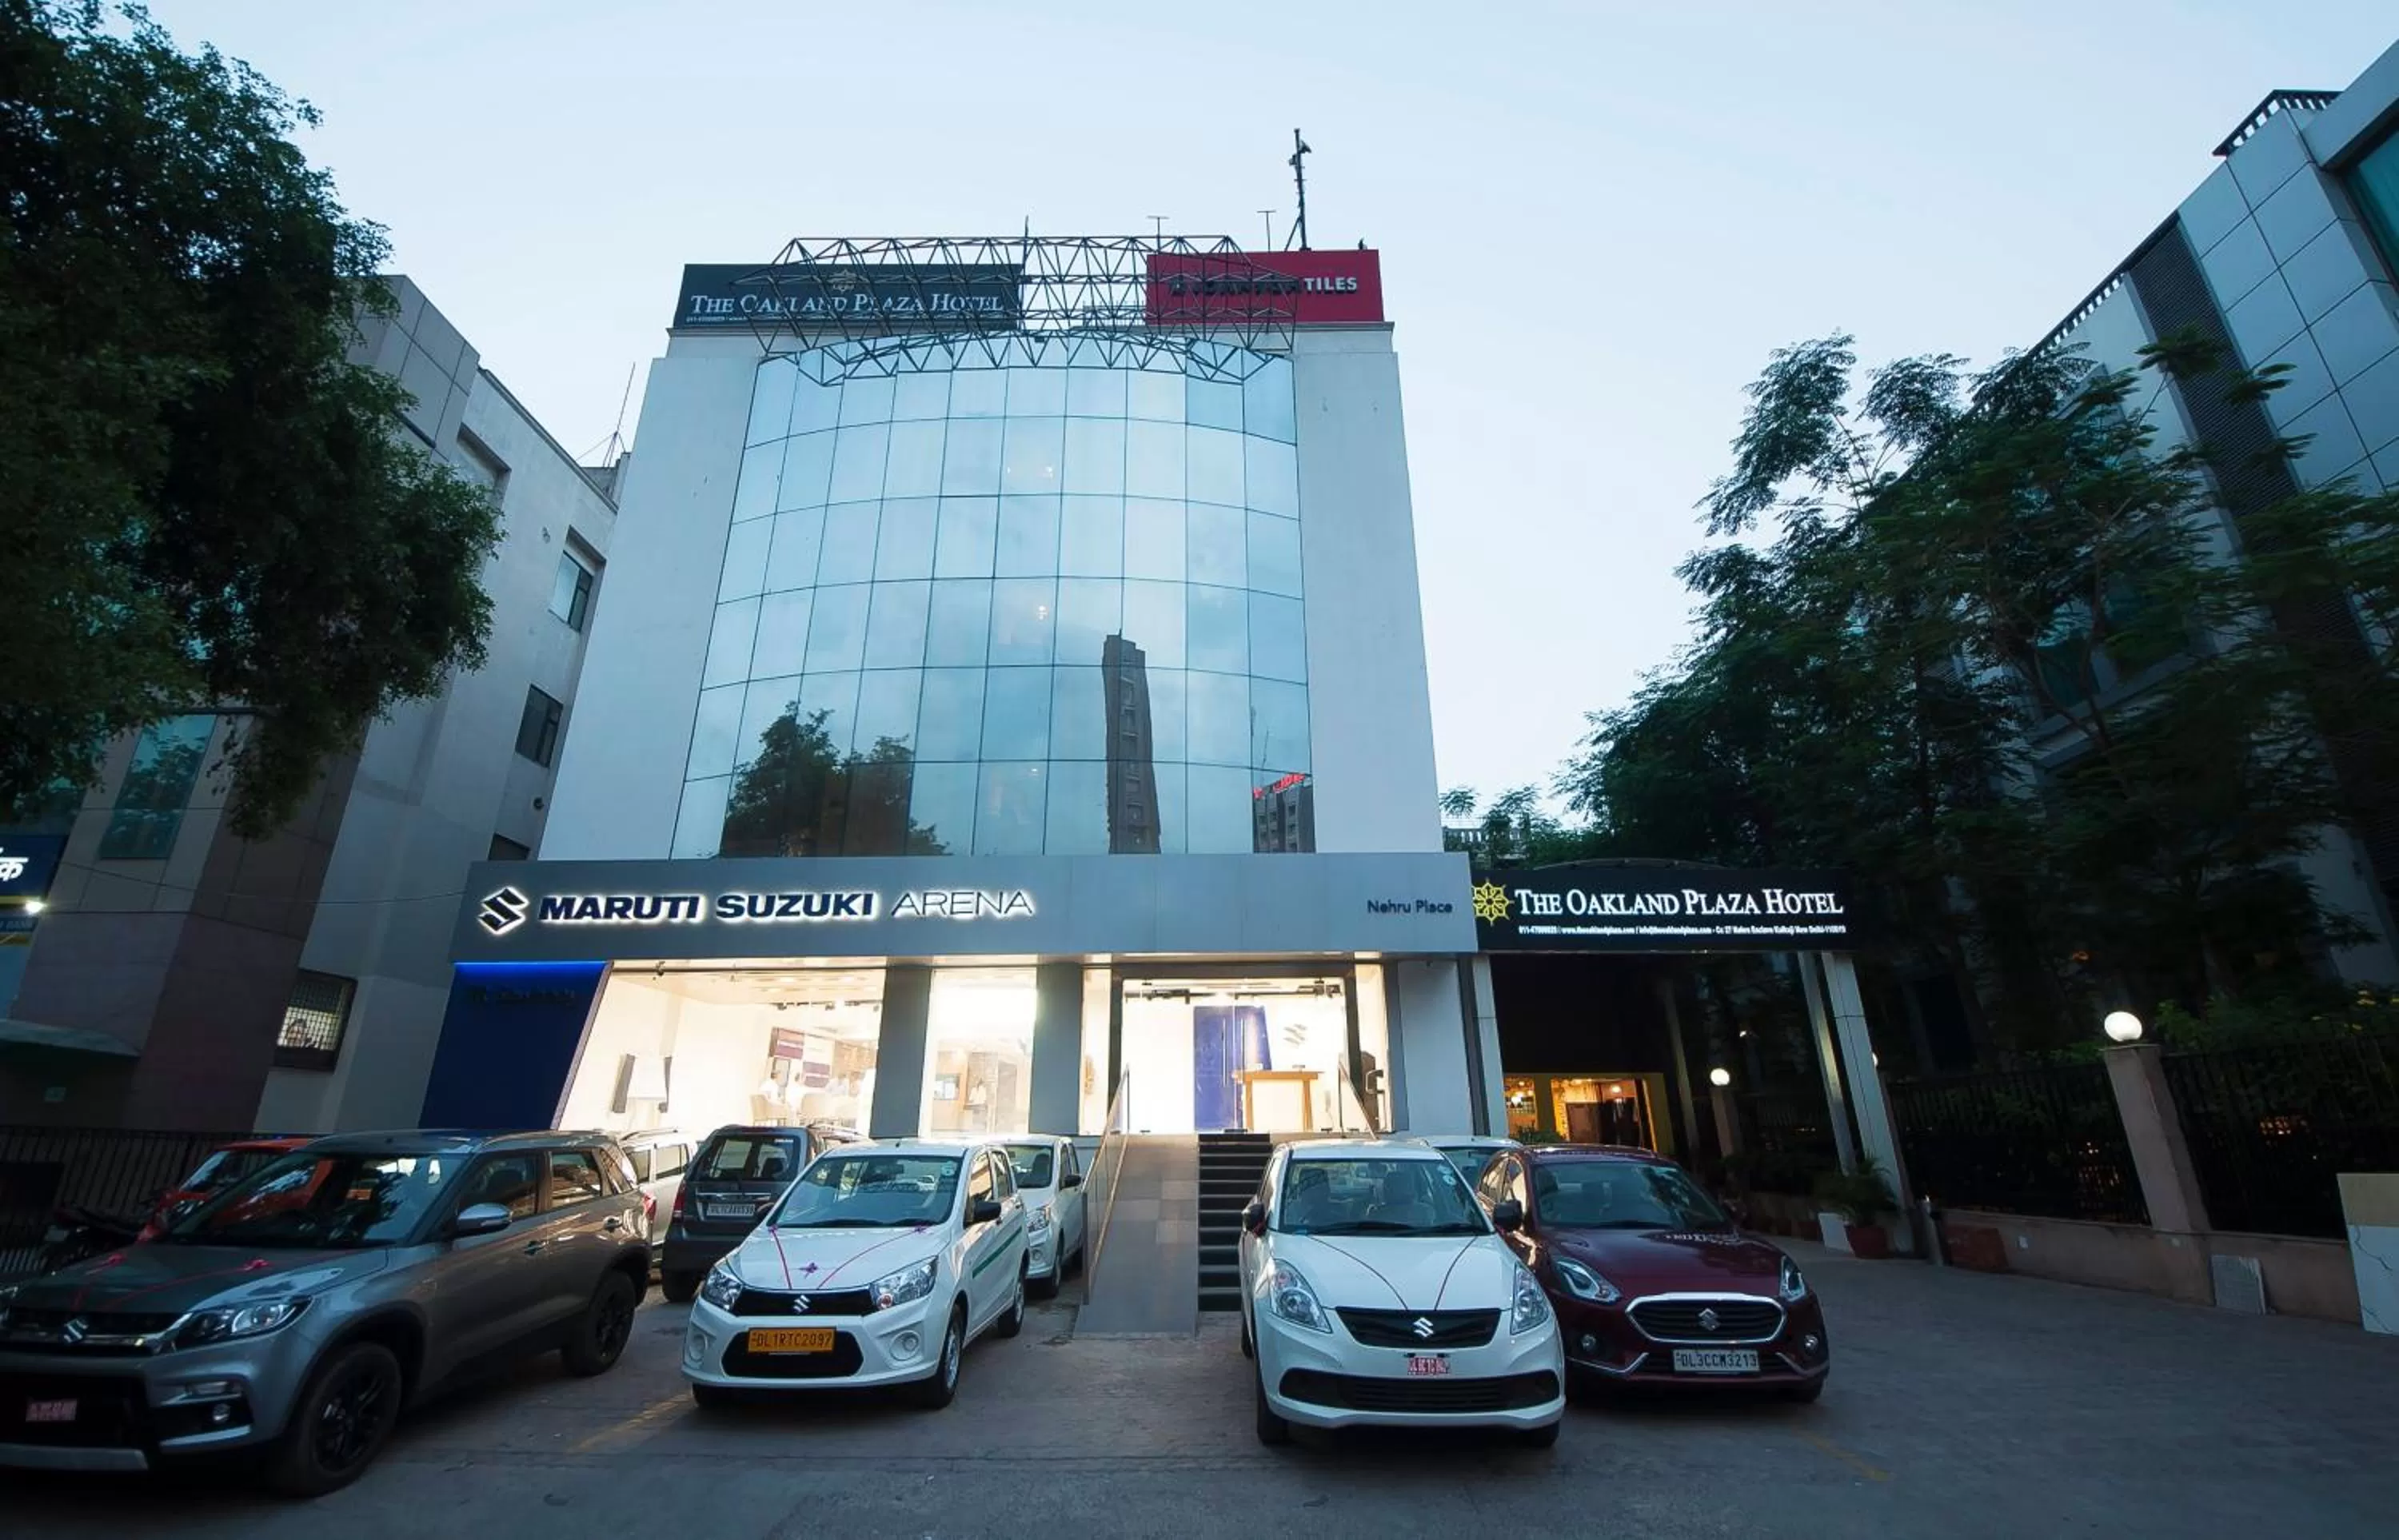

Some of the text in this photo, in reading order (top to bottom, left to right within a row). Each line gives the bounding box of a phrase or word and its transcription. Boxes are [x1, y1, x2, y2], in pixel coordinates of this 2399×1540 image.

[1303, 277, 1358, 291] TILES
[690, 294, 735, 314] THE
[537, 889, 1035, 921] MARUTI SUZUKI ARENA
[1367, 899, 1454, 914] Nehru Place
[1514, 888, 1844, 916] THE OAKLAND PLAZA HOTEL
